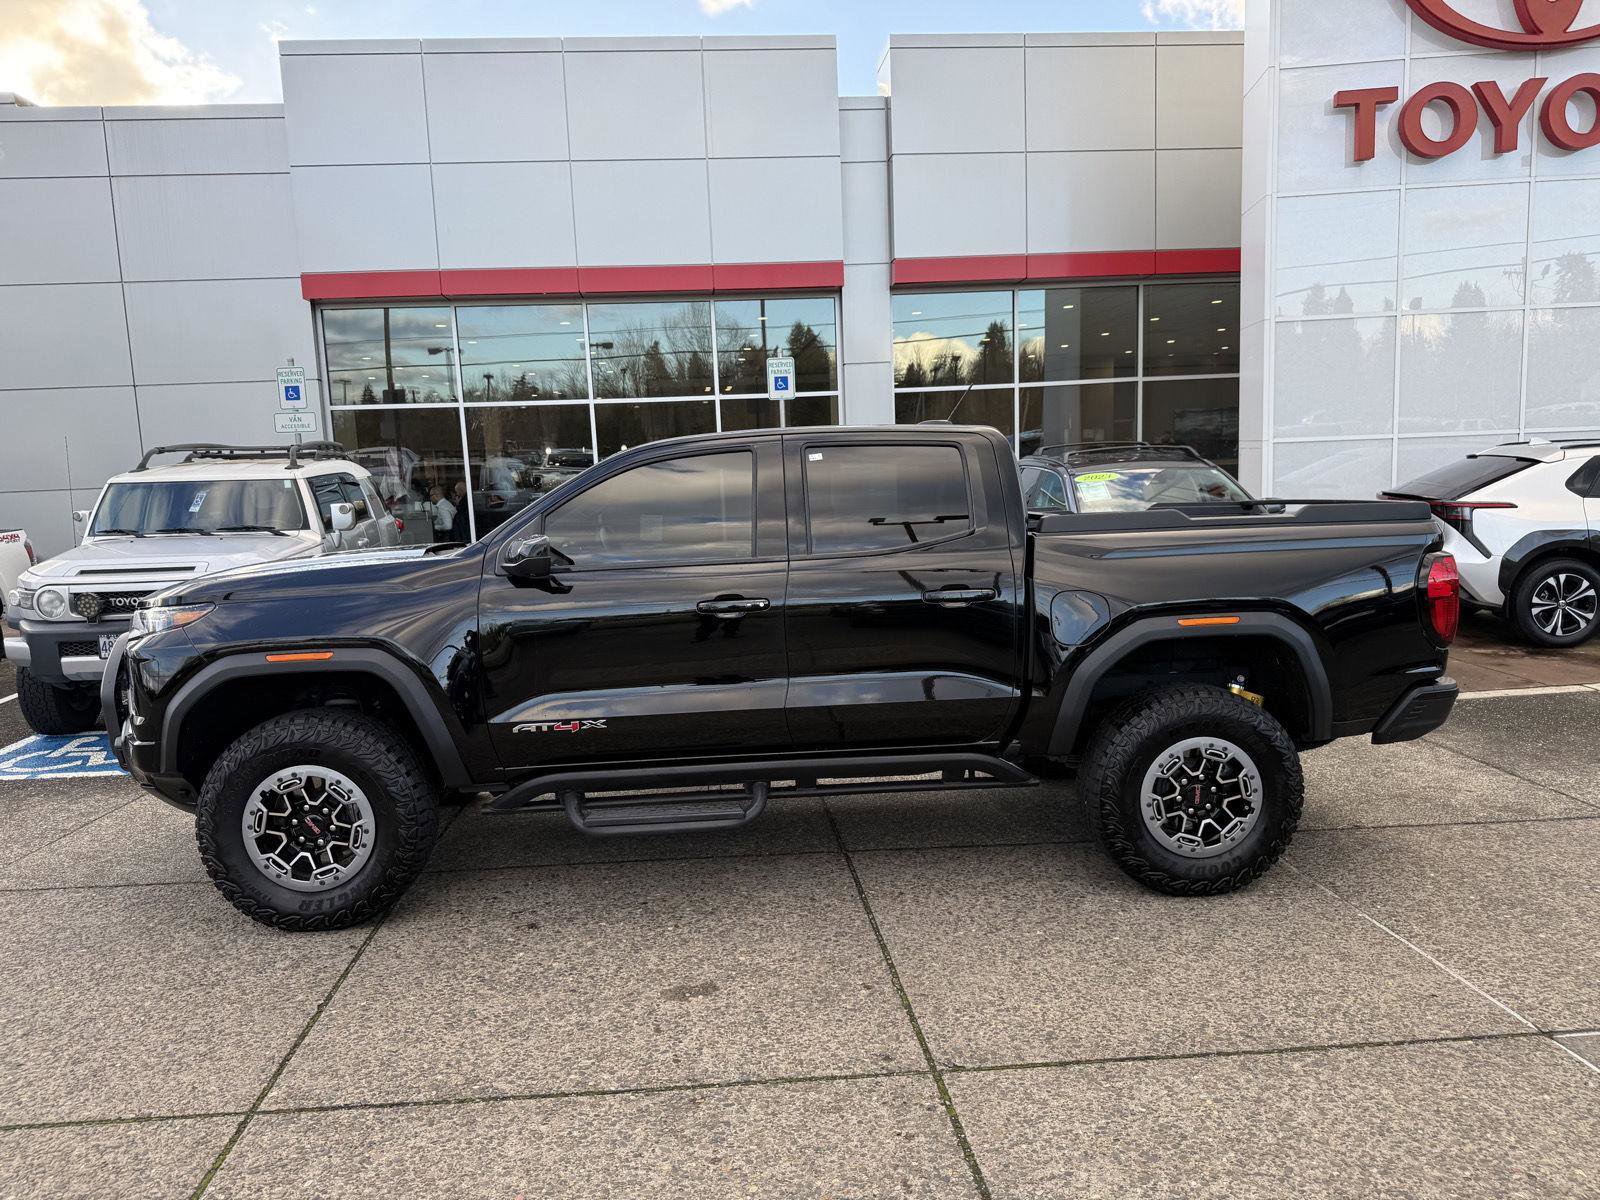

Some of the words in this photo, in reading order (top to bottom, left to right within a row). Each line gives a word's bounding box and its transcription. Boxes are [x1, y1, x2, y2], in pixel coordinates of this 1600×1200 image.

[109, 597, 143, 606] TOYO
[102, 640, 116, 653] 48
[512, 719, 608, 733] AT4X
[304, 817, 321, 834] GMC
